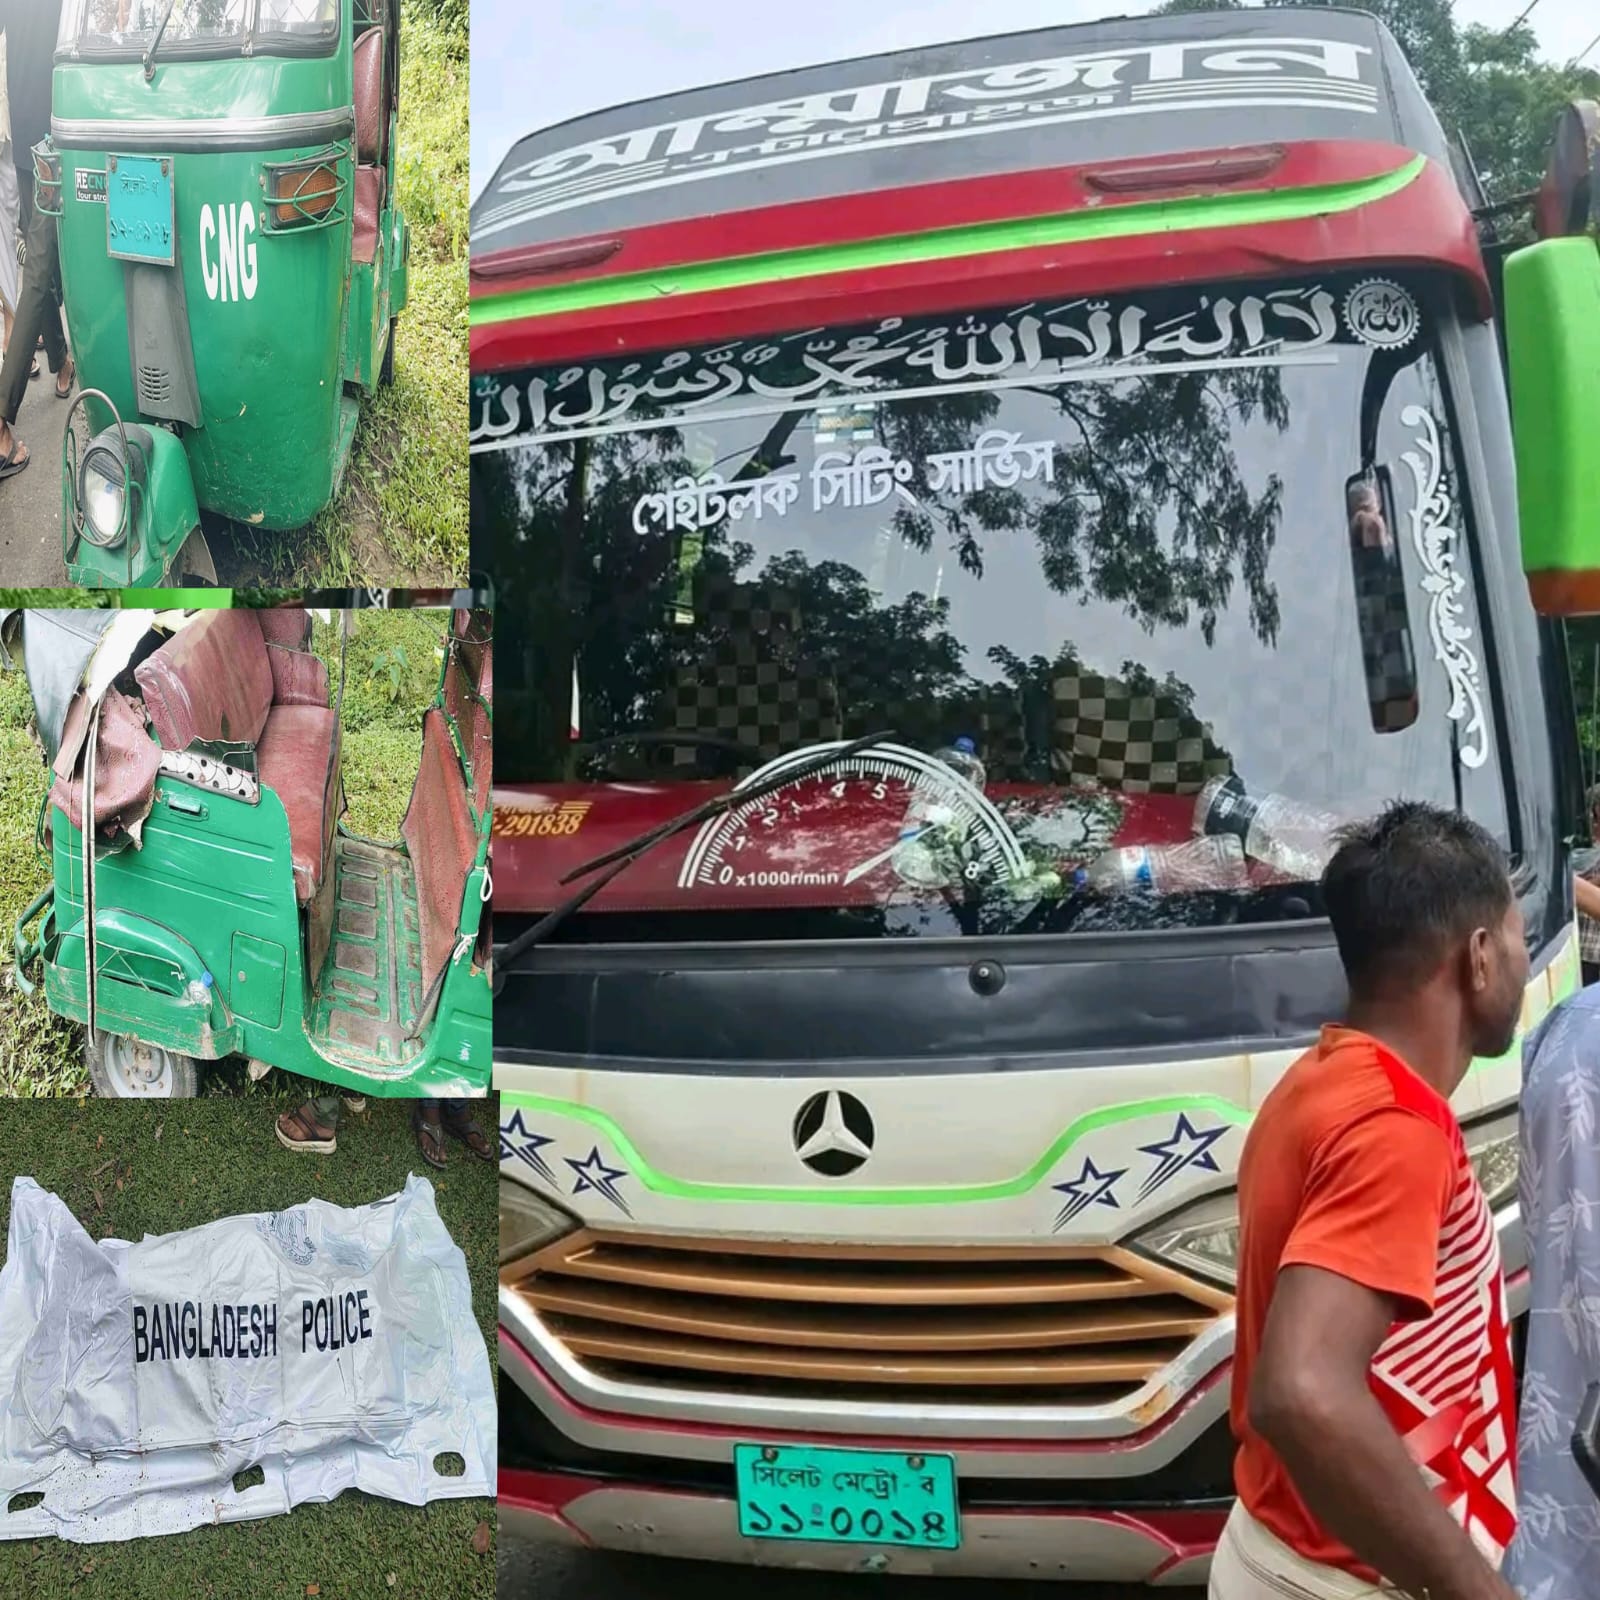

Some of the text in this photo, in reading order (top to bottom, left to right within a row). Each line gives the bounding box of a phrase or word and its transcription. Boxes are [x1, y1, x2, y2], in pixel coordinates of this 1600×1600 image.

[497, 37, 1372, 193] আম্মাজান
[200, 200, 258, 302] CNG
[632, 429, 1056, 535] গেইটলক সিটিং সার্ভিস
[831, 782, 847, 798] 4
[871, 782, 888, 800] 5
[762, 808, 779, 827] 2
[735, 835, 746, 852] 1
[719, 865, 840, 887] 0 x1000r/min
[964, 860, 980, 880] 8
[133, 1289, 373, 1363] BANGLADESH POLICE
[752, 1459, 822, 1489] সিলেট
[748, 1501, 946, 1541] ১১-০০১৪
